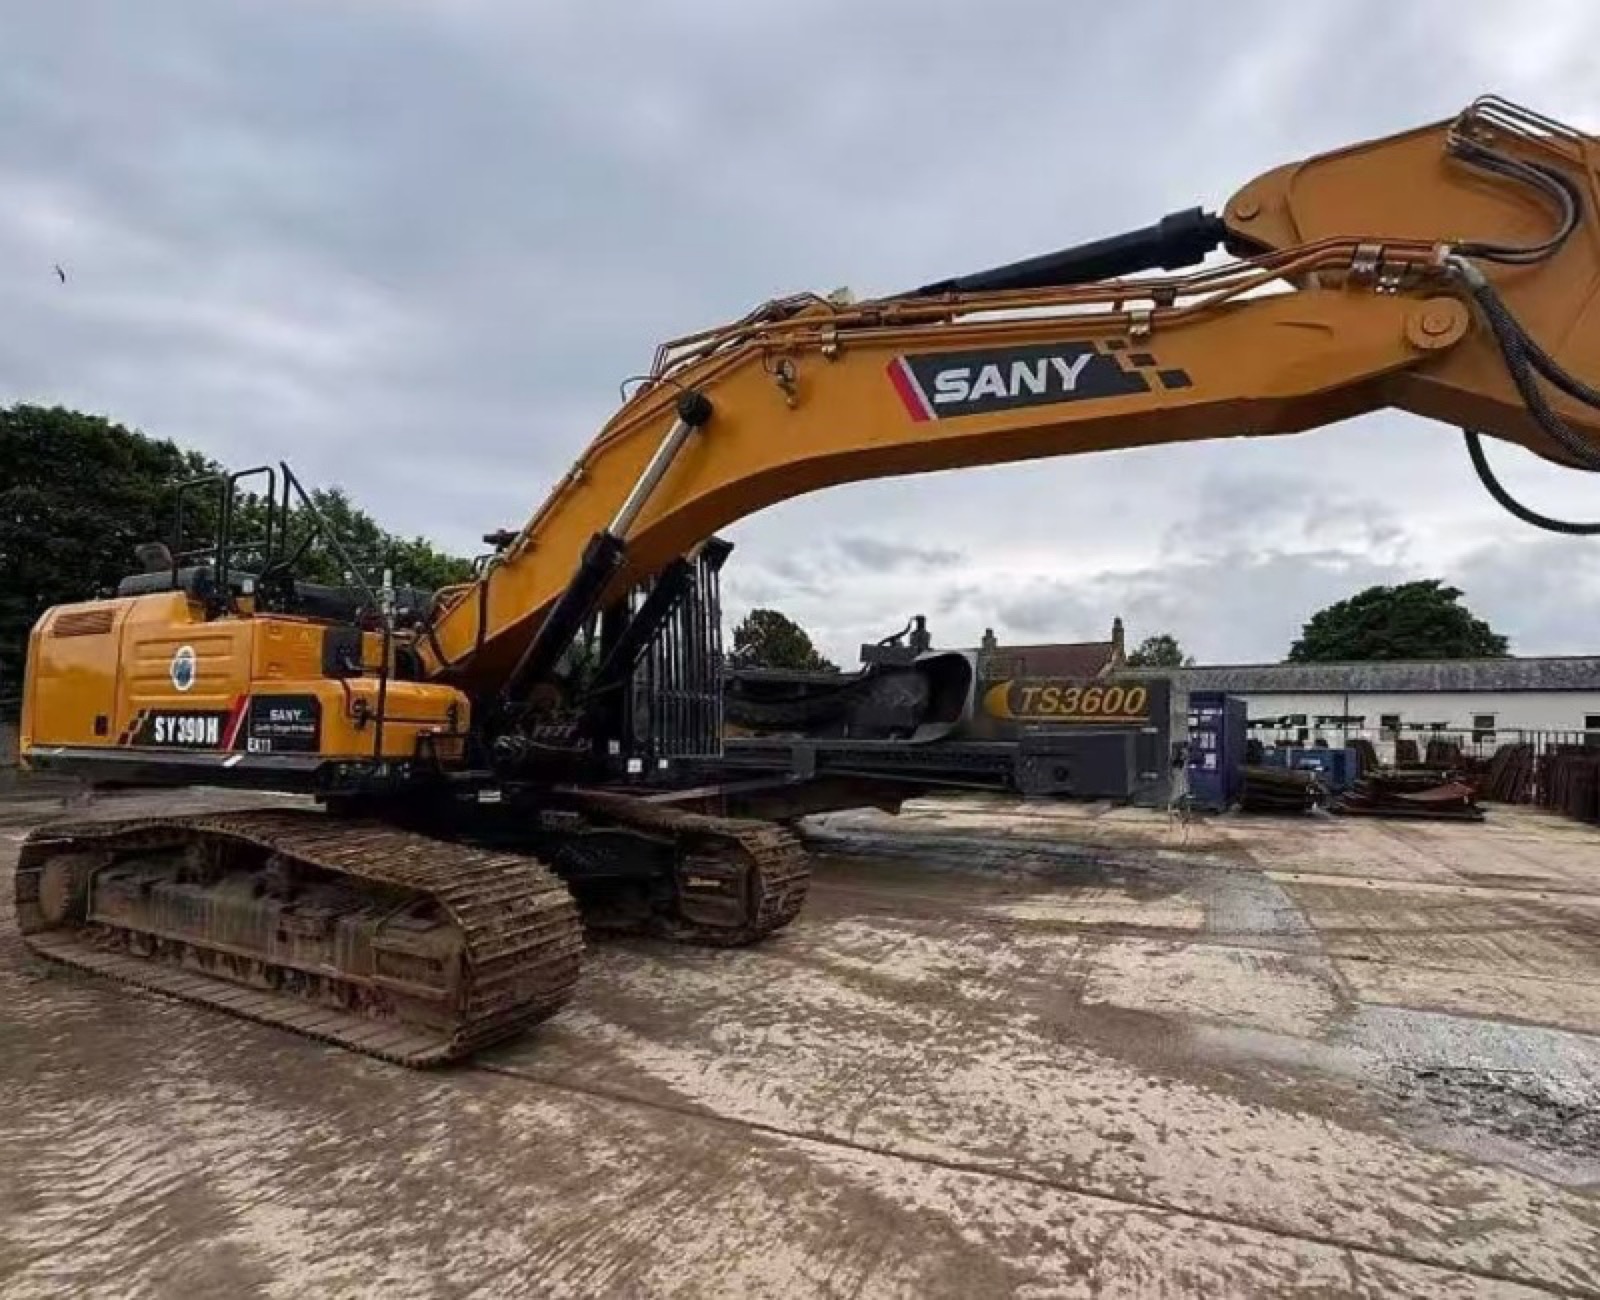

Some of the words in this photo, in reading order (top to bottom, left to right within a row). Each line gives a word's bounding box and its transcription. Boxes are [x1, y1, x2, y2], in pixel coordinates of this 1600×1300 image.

[933, 353, 1094, 403] SANY
[1020, 687, 1147, 714] TS3600
[154, 715, 219, 744] SY390H
[269, 709, 302, 722] SANY
